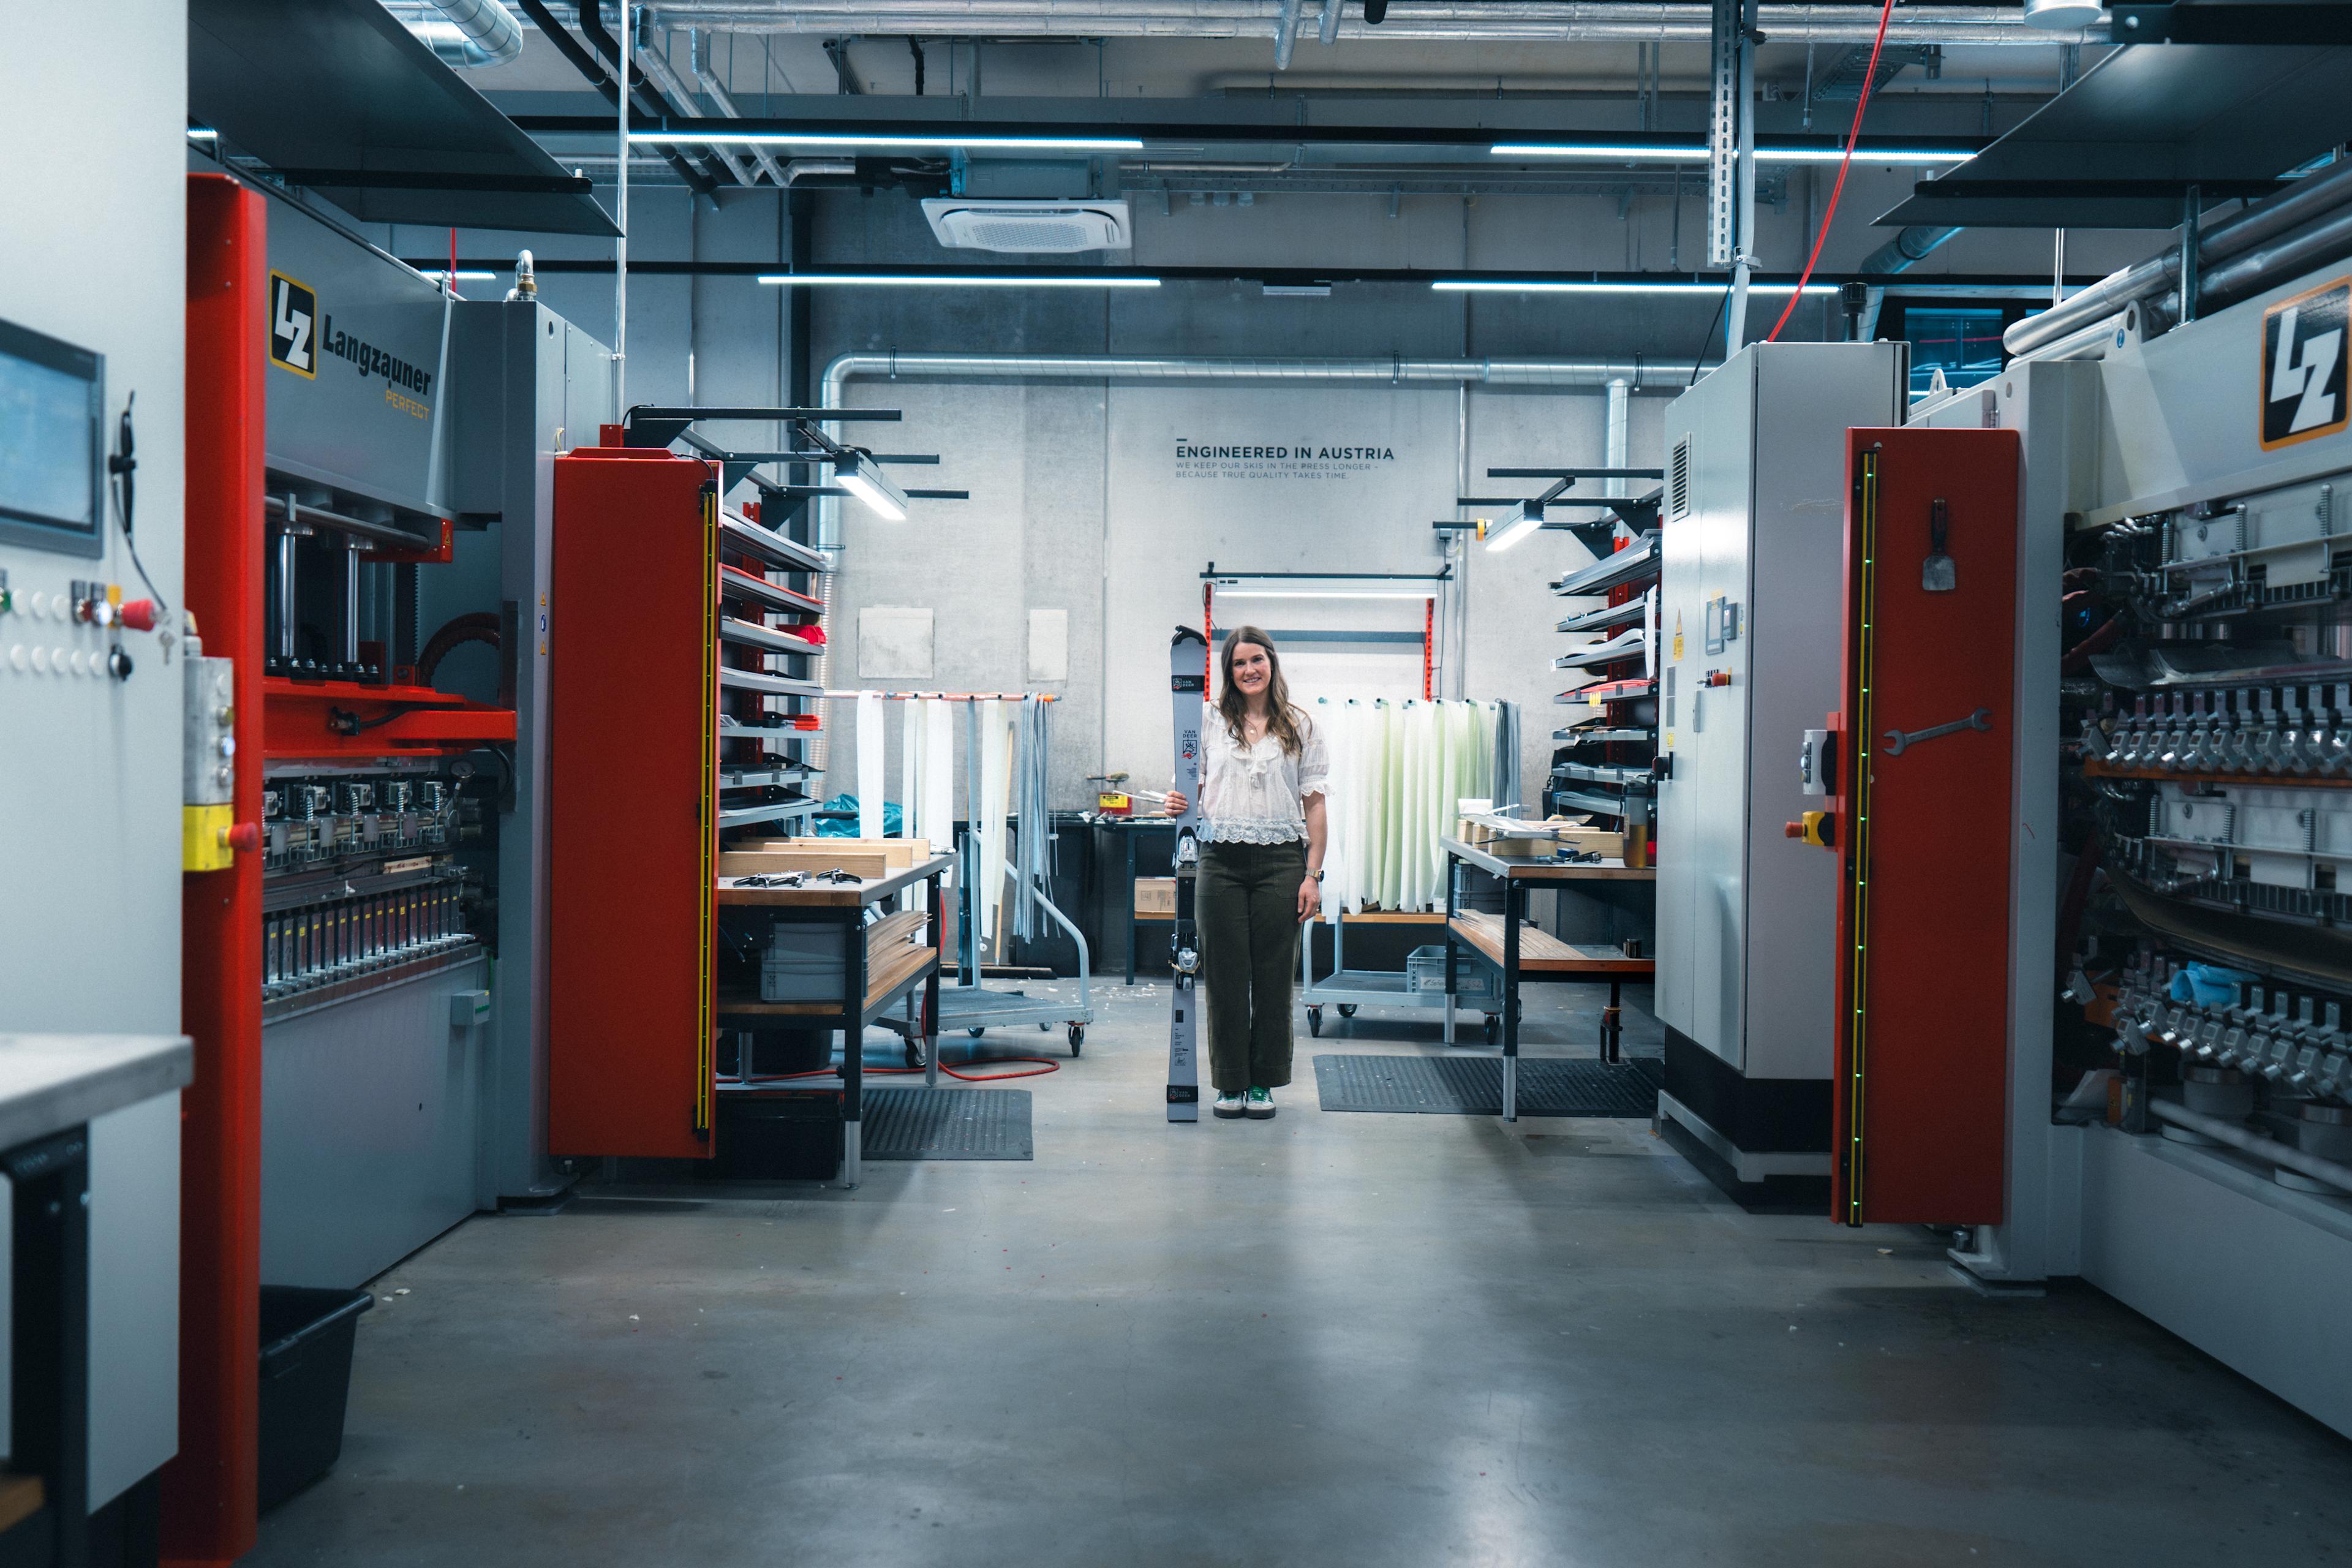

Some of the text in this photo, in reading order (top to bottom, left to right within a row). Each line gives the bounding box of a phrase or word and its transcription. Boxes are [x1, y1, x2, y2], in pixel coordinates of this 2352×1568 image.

[323, 314, 431, 396] Langzauner
[385, 389, 430, 421] PERFECT
[1177, 446, 1394, 459] ENGINEERED IN AUSTRIA
